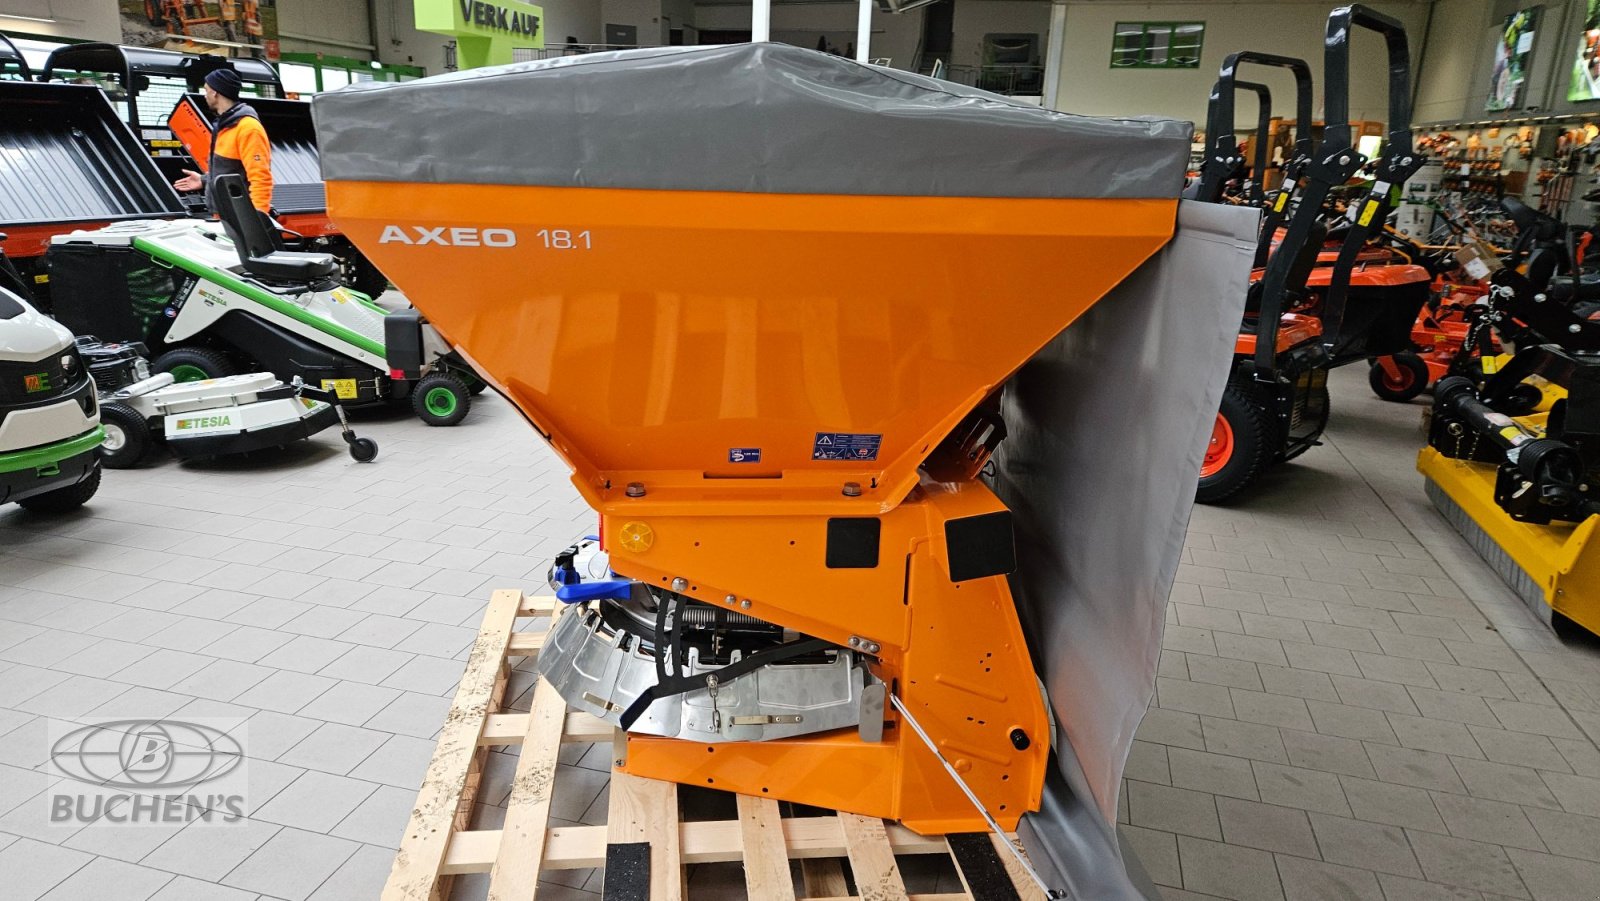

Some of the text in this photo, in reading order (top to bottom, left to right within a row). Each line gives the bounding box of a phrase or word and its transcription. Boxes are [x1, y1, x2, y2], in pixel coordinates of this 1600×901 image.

[460, 0, 540, 37] VERKAUF
[378, 225, 592, 250] AXEO 18.1
[177, 415, 231, 430] ETESIA
